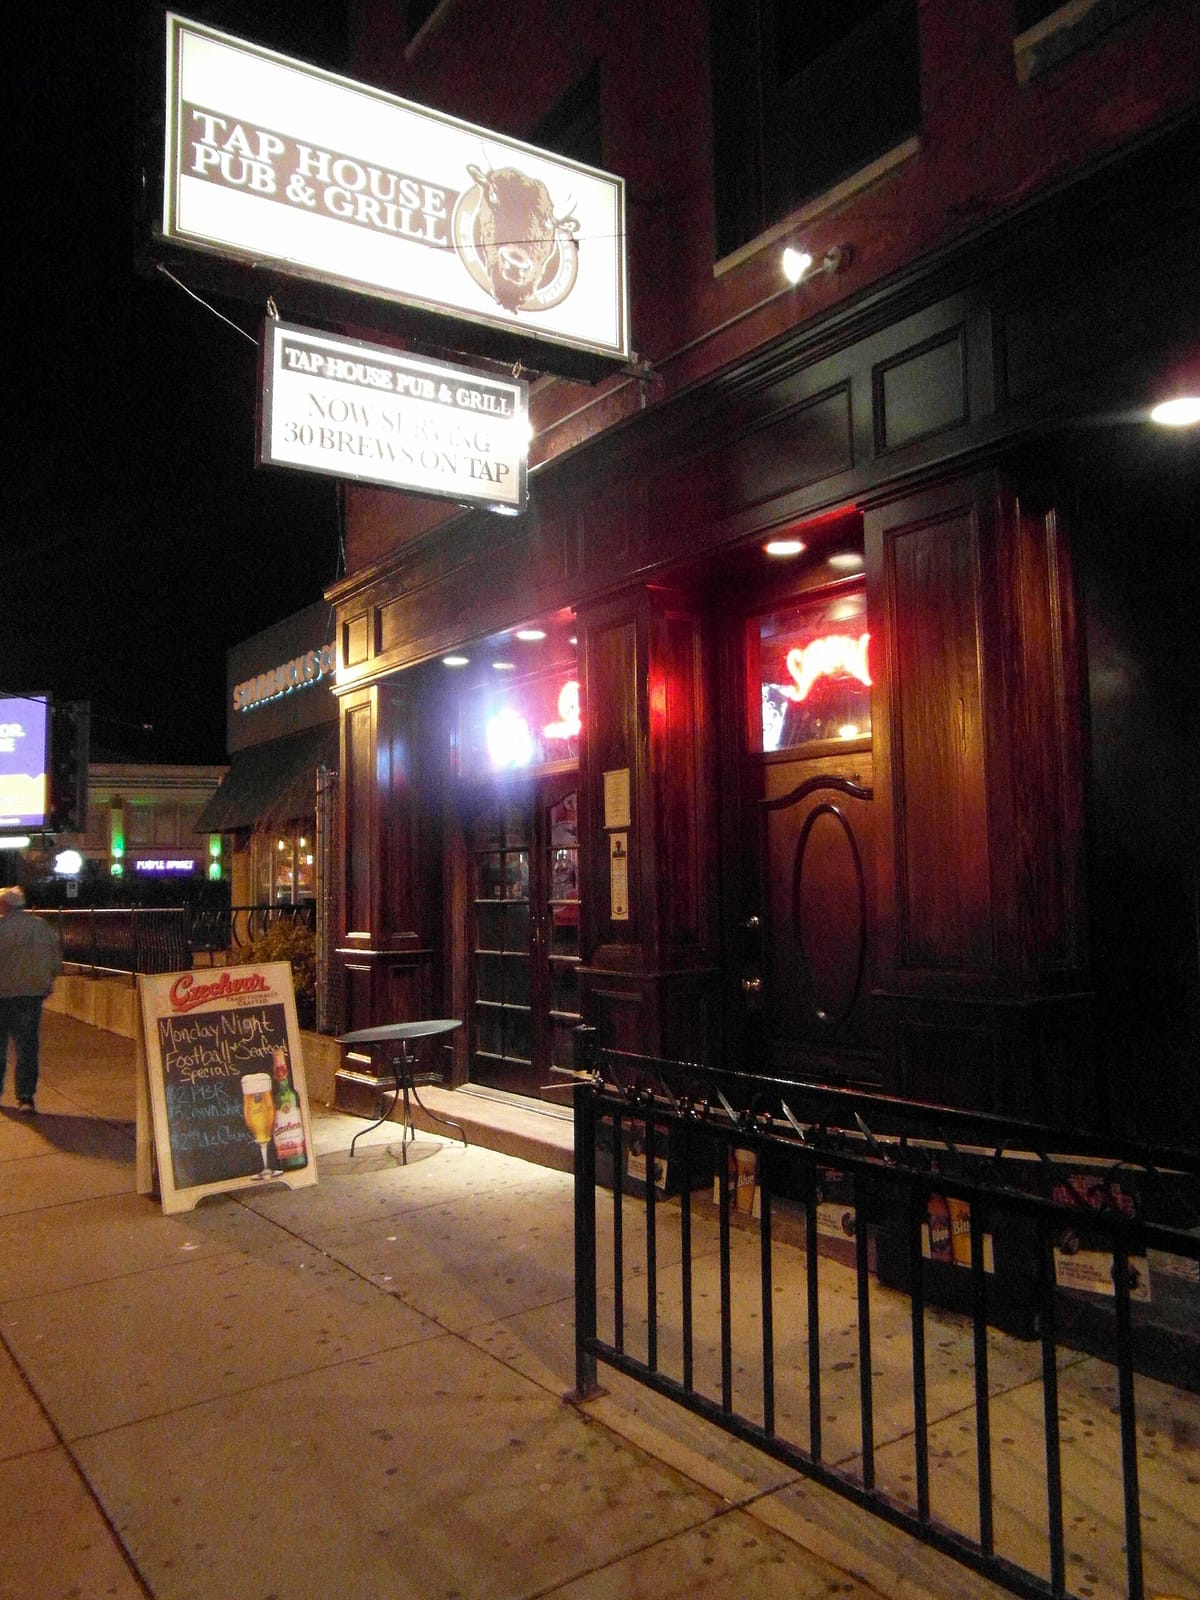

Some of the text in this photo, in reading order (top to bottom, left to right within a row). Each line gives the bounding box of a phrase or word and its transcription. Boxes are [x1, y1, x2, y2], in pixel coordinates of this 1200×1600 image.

[191, 141, 277, 193] PUB
[285, 174, 316, 206] &
[323, 186, 449, 246] GRILL
[192, 110, 448, 218] TAP HOUSE
[285, 347, 513, 416] TAP HOUSE PUB & GRILL
[308, 392, 374, 428] NOW
[284, 421, 510, 484] 30 BREWS ON TAP
[233, 650, 319, 711] STARBUCKS
[160, 1010, 274, 1052] Monday Night
[166, 1039, 231, 1073] Football
[952, 1220, 970, 1235] Blu
